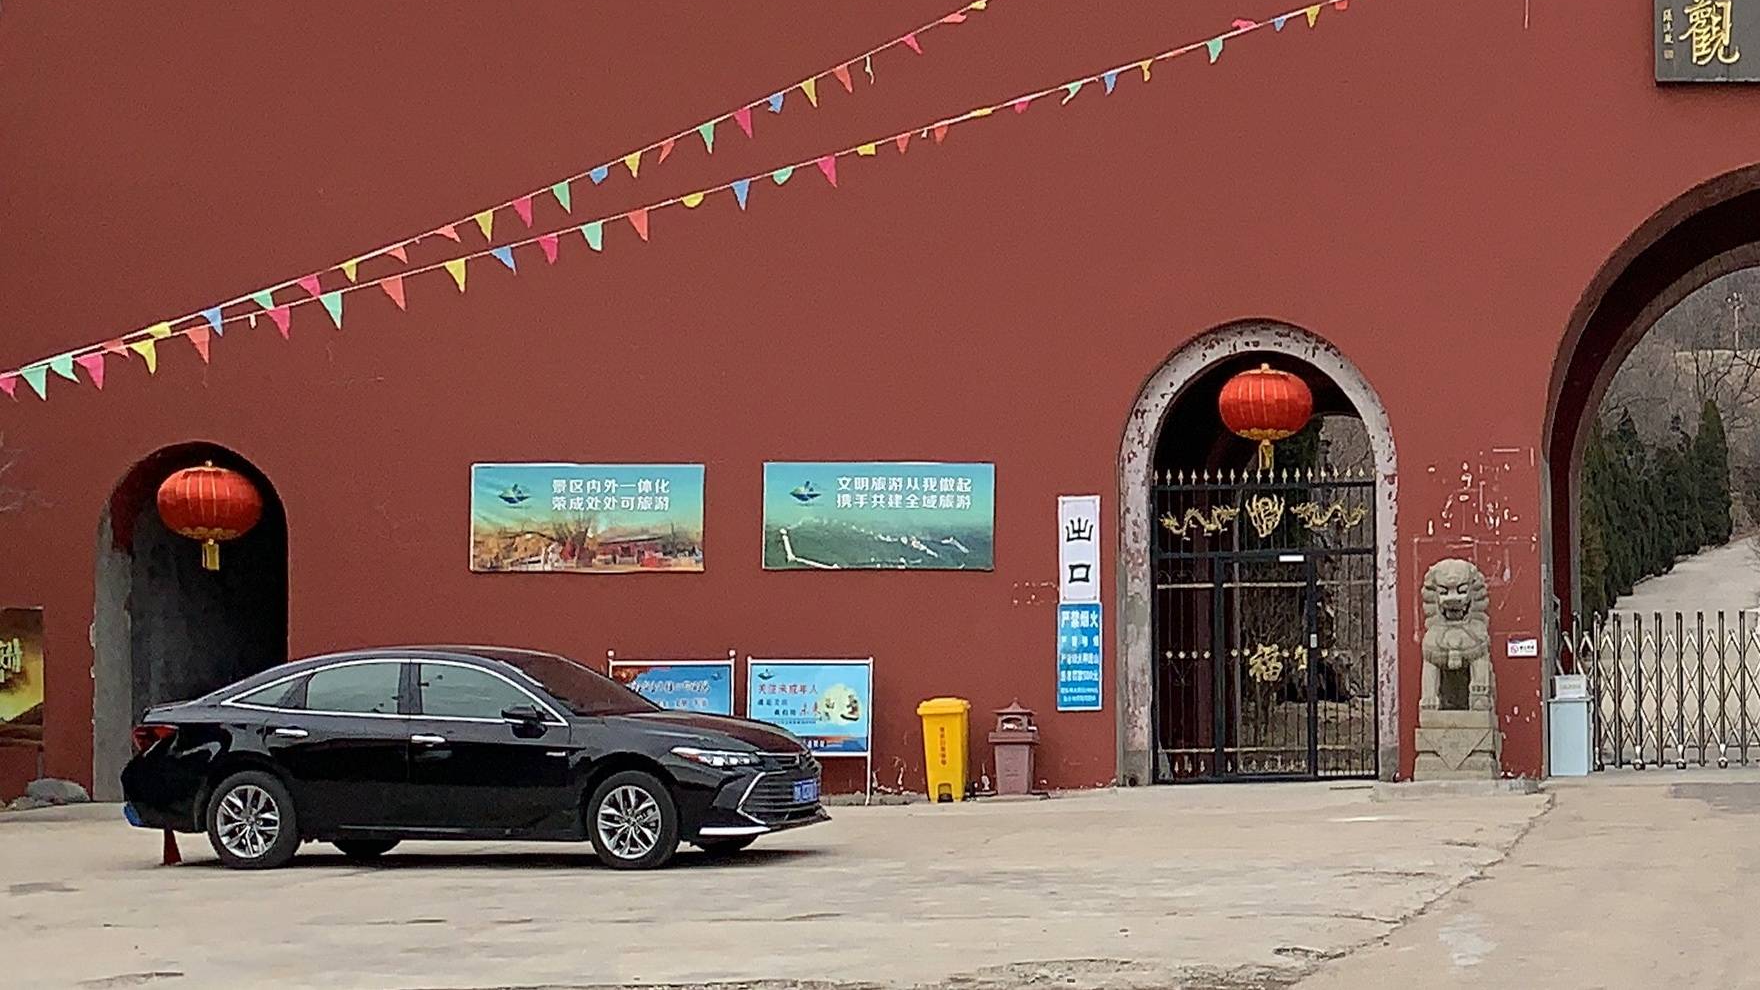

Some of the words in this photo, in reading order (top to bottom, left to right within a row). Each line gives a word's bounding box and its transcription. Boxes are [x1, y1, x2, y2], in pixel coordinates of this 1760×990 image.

[552, 478, 670, 494] 景区内外一体化
[836, 476, 972, 492] 文明旅游从我做起
[551, 496, 670, 512] 荣成处处可旅游
[836, 493, 972, 509] 携手共建全域旅游
[1065, 517, 1094, 584] 出口
[1060, 610, 1099, 629] 严禁烟火
